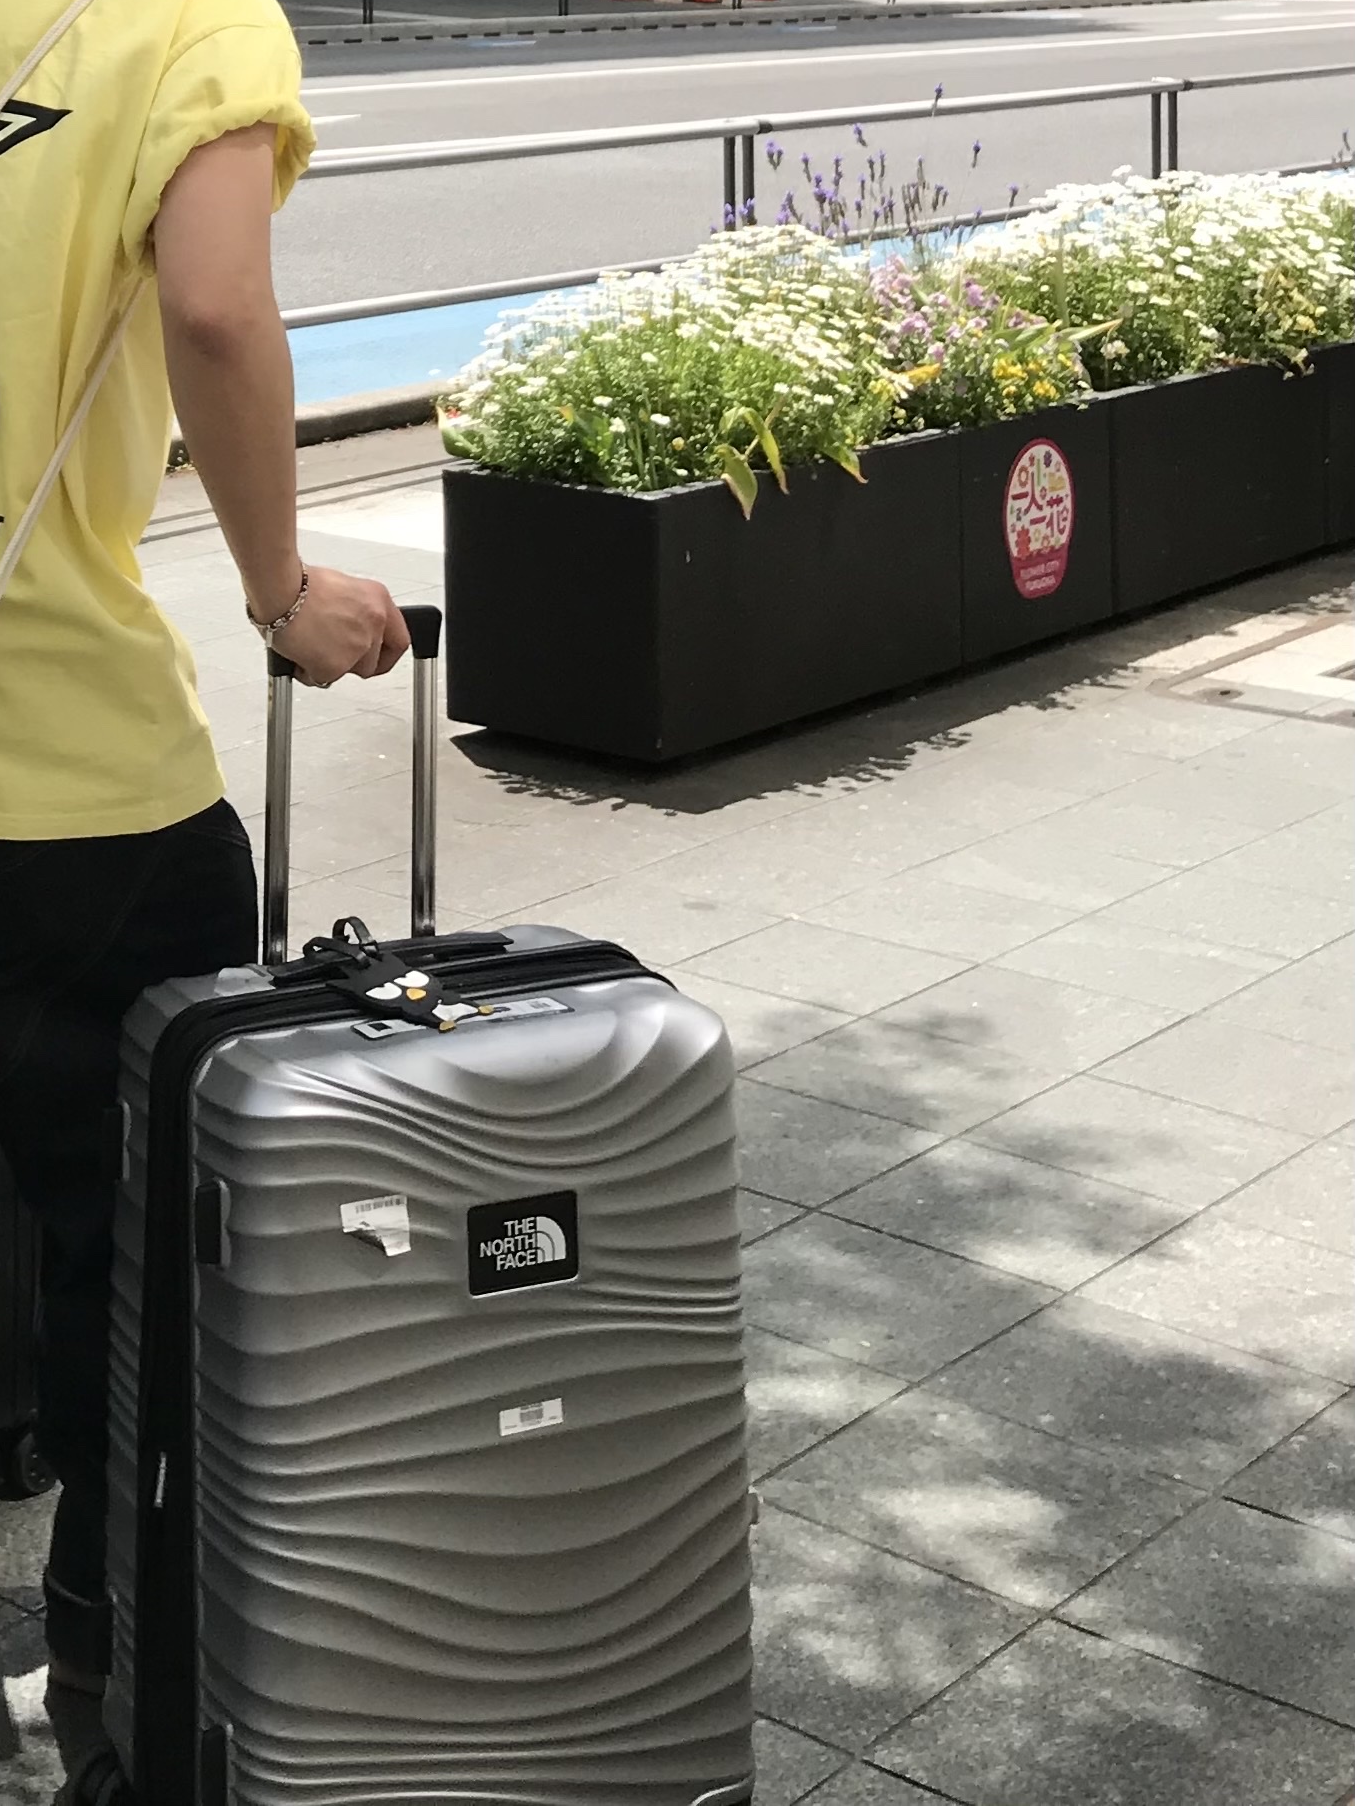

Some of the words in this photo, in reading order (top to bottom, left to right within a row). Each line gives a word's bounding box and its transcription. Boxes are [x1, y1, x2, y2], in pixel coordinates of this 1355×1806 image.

[503, 1216, 536, 1237] THE
[479, 1233, 536, 1258] NORTH
[496, 1249, 536, 1271] FACE
